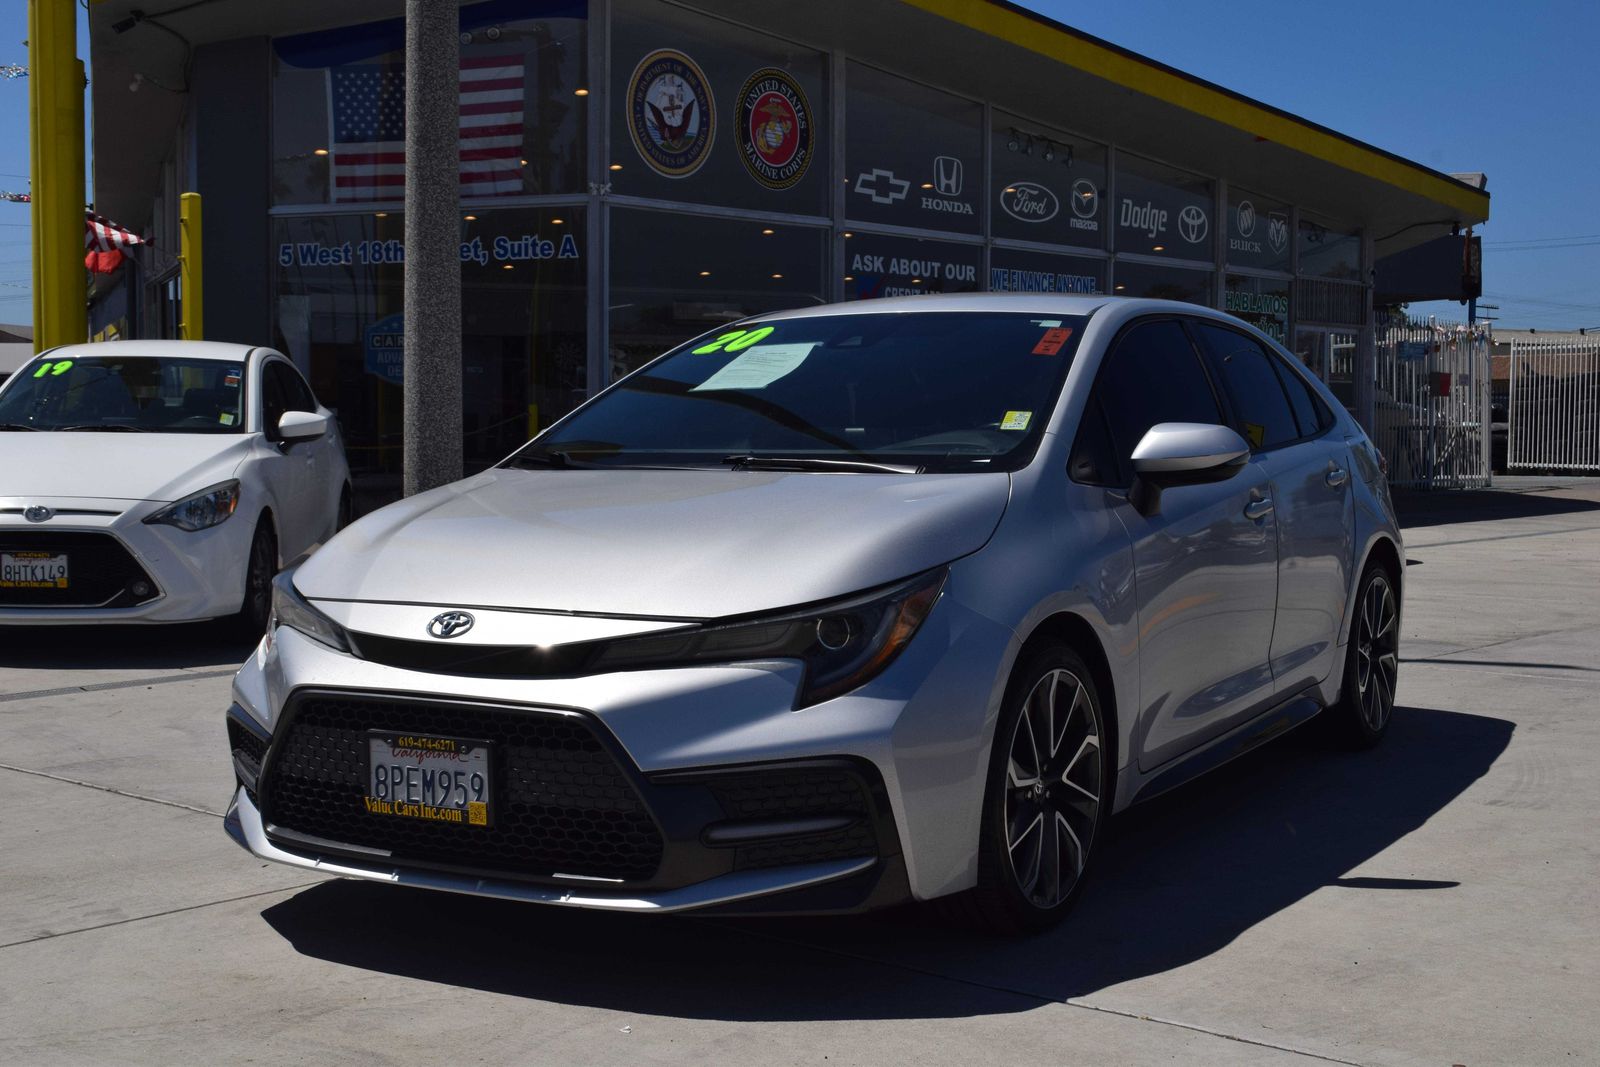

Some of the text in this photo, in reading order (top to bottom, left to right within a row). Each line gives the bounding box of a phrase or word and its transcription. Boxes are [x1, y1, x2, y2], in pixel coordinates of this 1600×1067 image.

[745, 79, 807, 129] UNITED STATES
[744, 141, 807, 179] MARINE CORPS
[921, 197, 974, 215] HONDA
[1013, 186, 1047, 216] Ford
[1120, 198, 1168, 238] Dodge
[279, 243, 293, 267] 5
[298, 242, 352, 266] West
[357, 239, 404, 264] 18th
[493, 233, 554, 260] Suite
[558, 232, 579, 259] A
[1229, 238, 1262, 254] BUICK
[851, 253, 976, 282] ASK ABOUT OUR
[992, 268, 1009, 292] WE
[1010, 269, 1055, 293] FINANCE
[1225, 290, 1288, 315] HABLAMOS
[691, 326, 775, 355] 20
[33, 360, 73, 378] 19
[4, 564, 66, 582] 8HTK149
[399, 737, 456, 750] 619-474-6271
[375, 764, 484, 808] 8PEM959
